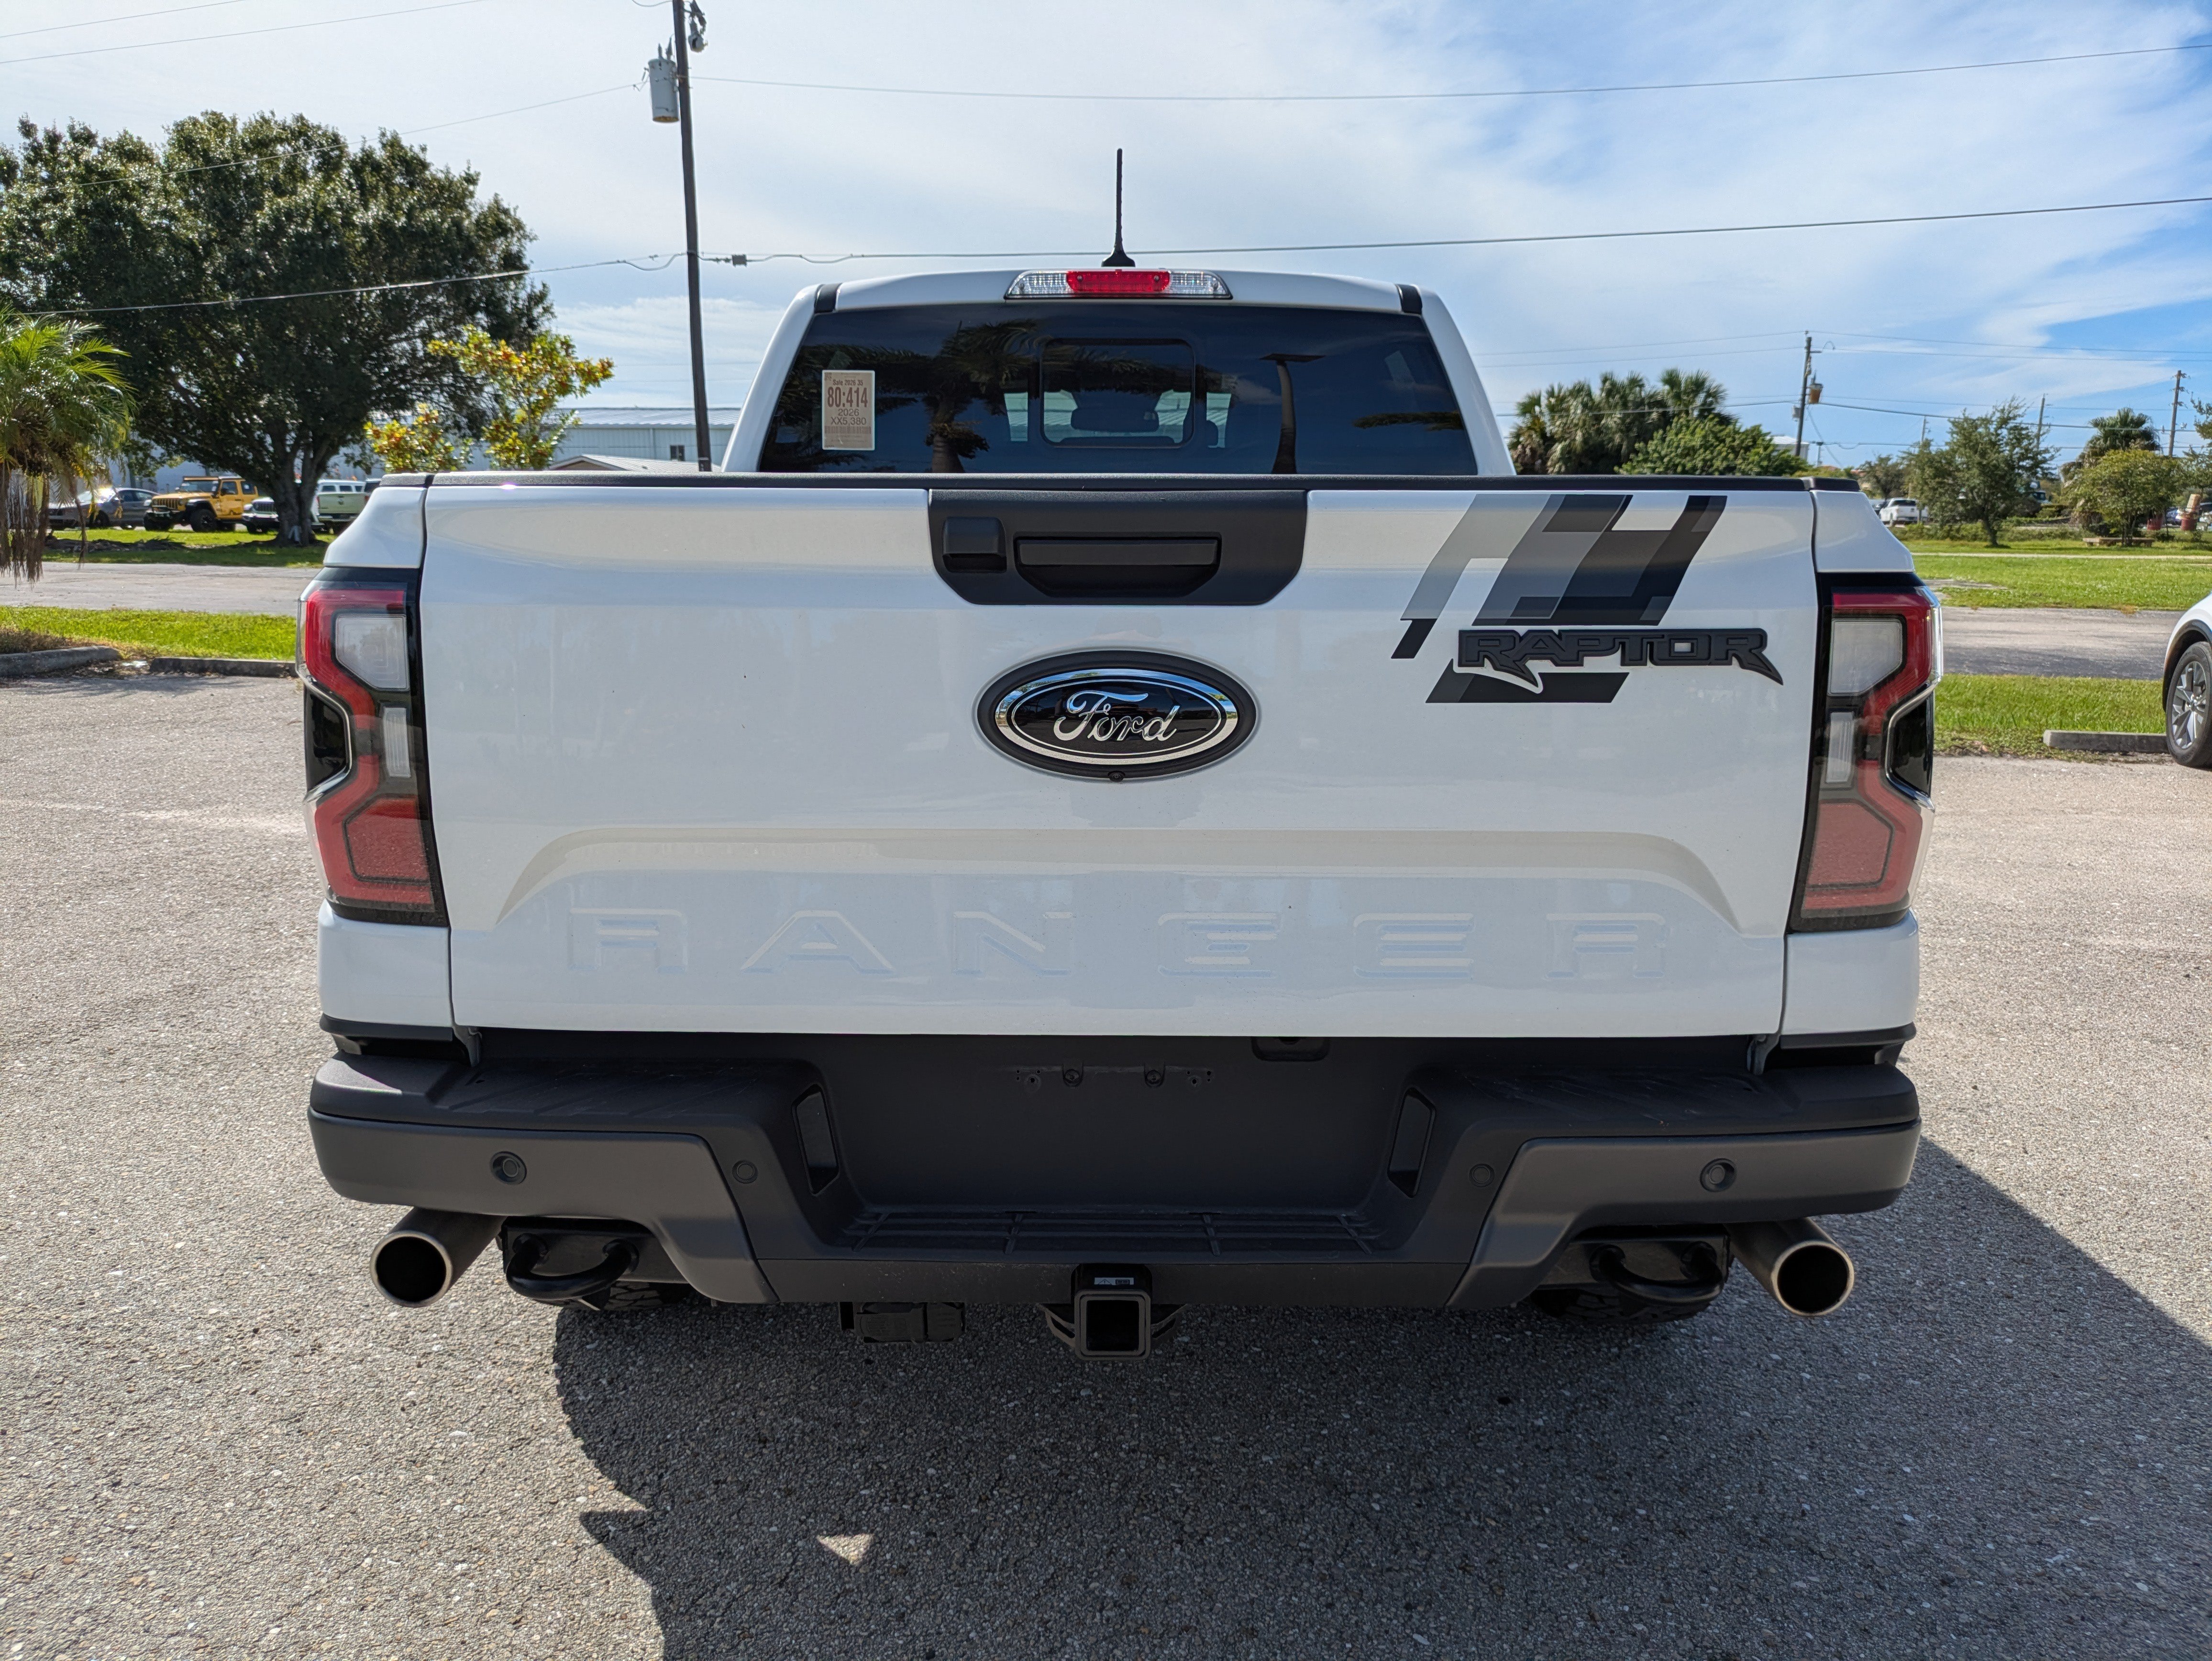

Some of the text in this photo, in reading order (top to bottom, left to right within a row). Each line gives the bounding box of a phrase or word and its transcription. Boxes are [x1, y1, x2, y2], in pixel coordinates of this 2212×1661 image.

[828, 387, 868, 408] 80:414
[831, 417, 866, 425] XX5,380
[1458, 628, 1783, 686] RAPTOR
[1053, 690, 1180, 741] Ford
[569, 908, 1667, 980] RANGER
